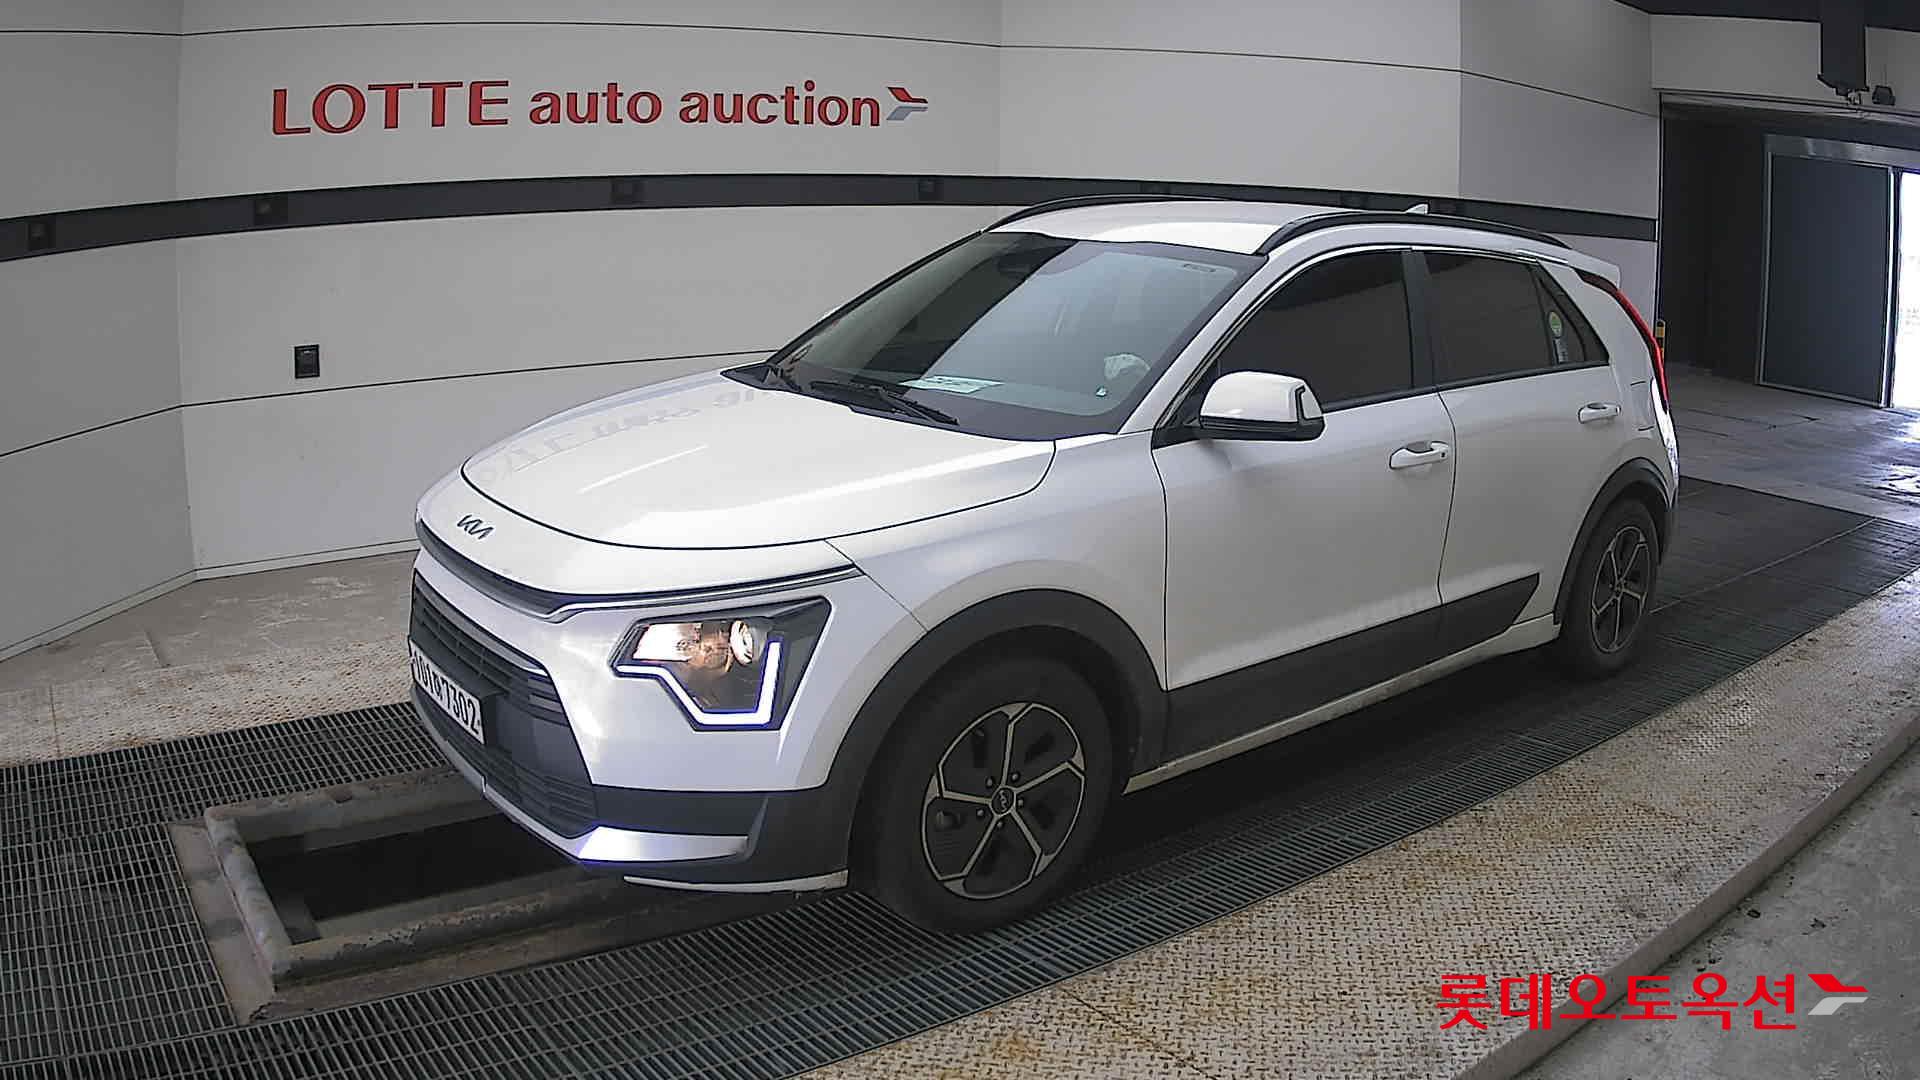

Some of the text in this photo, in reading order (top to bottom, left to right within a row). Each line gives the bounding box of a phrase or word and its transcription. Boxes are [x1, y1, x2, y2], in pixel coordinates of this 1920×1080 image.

[272, 80, 880, 135] LOTTE auto auction
